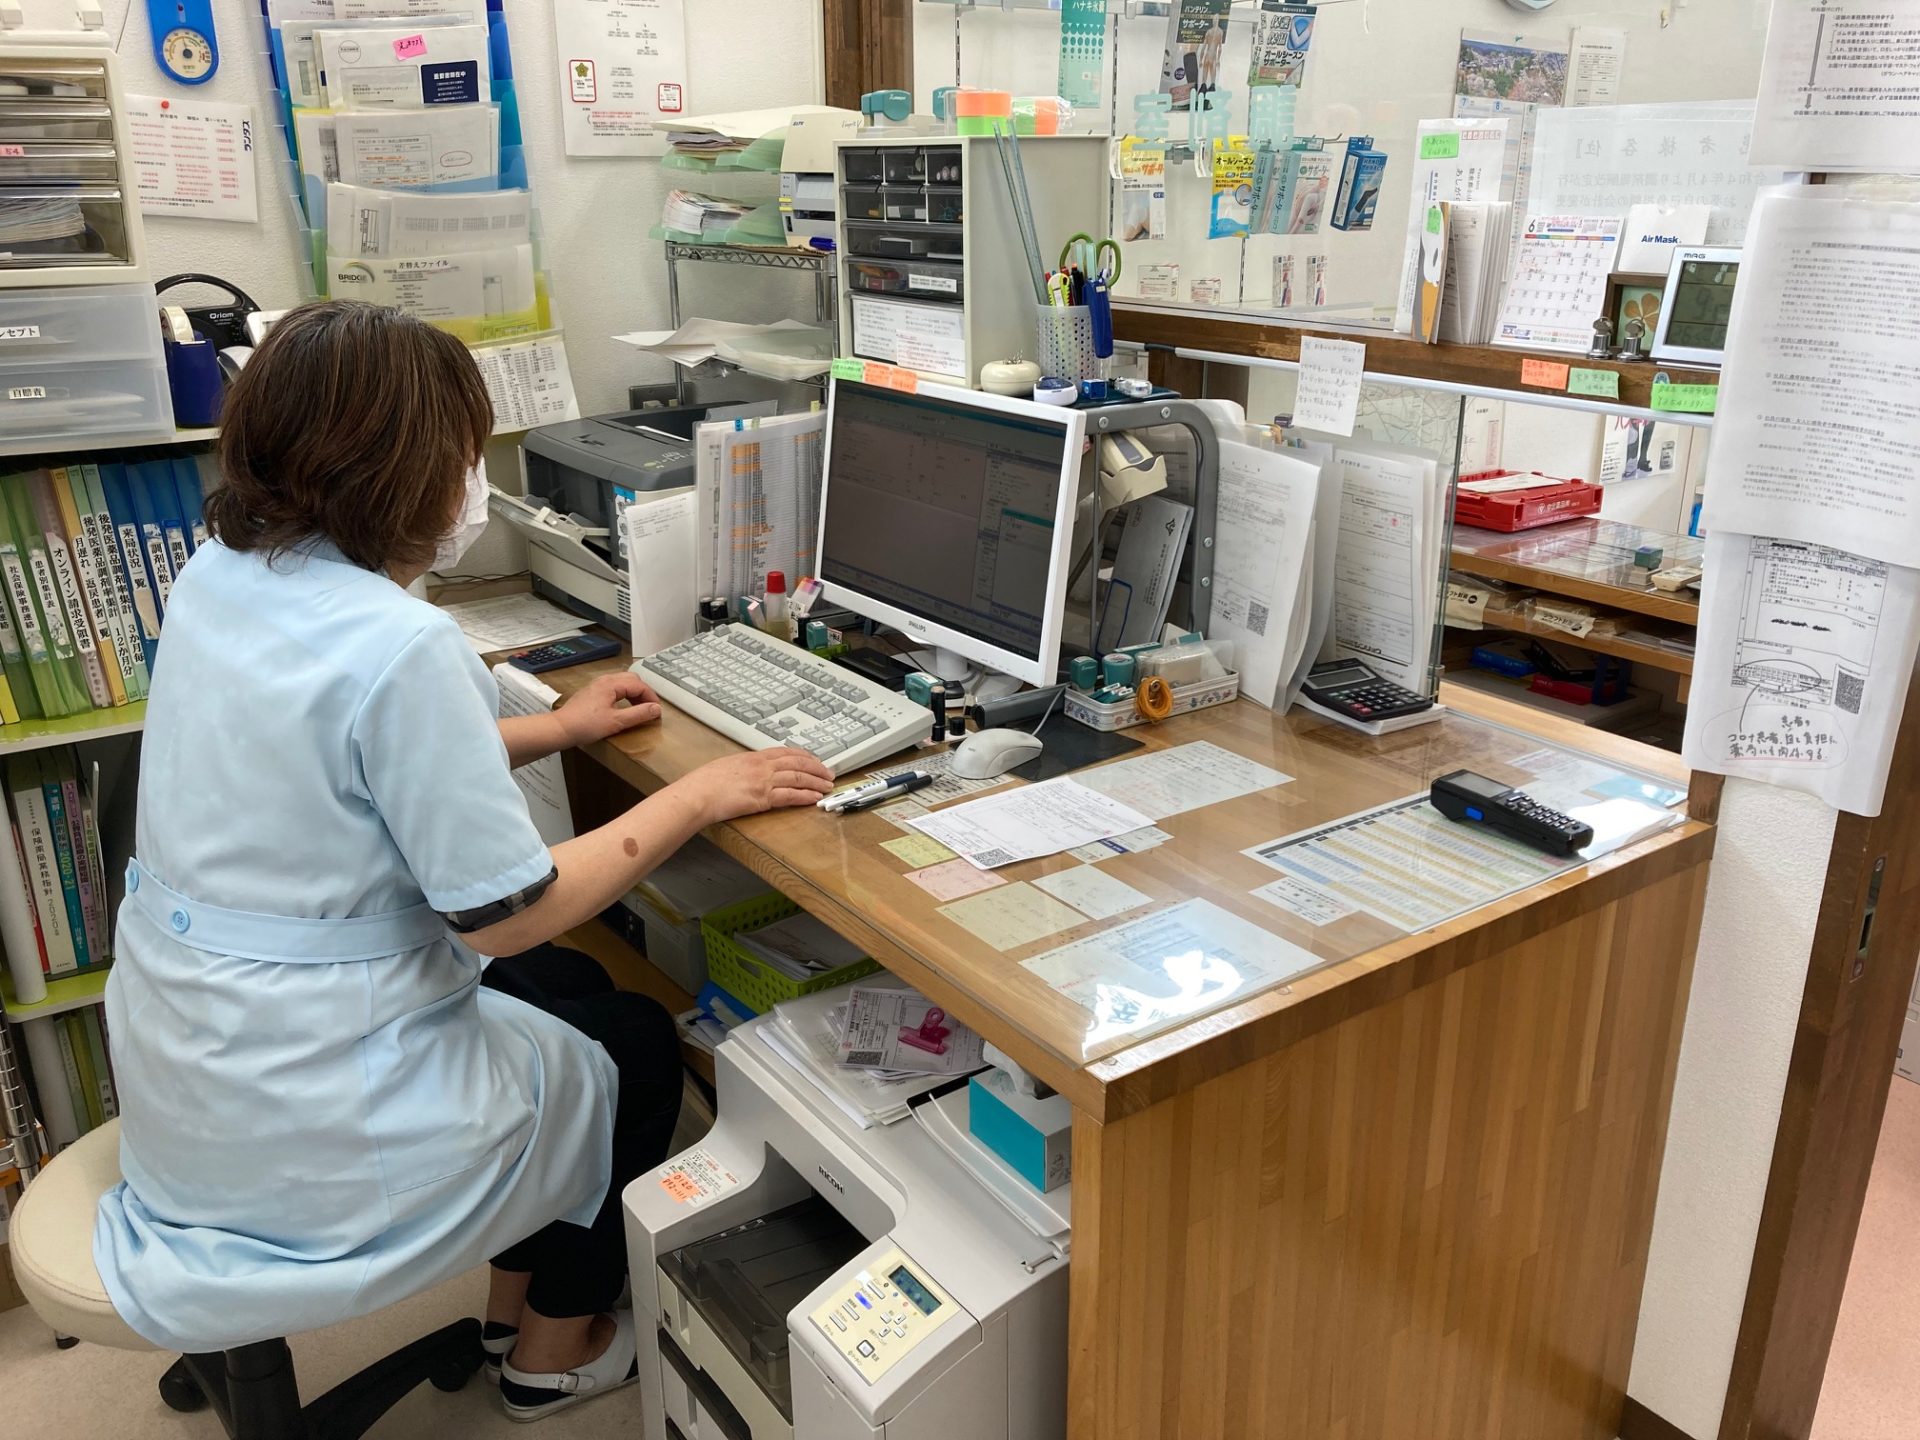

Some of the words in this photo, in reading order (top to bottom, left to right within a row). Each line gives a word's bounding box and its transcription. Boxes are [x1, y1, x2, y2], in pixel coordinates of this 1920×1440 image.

[1263, 58, 1291, 67] サポーター
[1264, 50, 1305, 59] オールシーズン
[338, 273, 368, 281] BRIDGE
[12, 387, 43, 398] 自賠責
[121, 527, 148, 589] 来局状況一覧
[34, 560, 56, 609] 患者別集計表
[9, 566, 35, 630] 社会保険事務連絡
[54, 547, 91, 650] オンライン請求受領書
[908, 620, 927, 632] PHILIPS
[818, 1165, 844, 1195] RICOH
